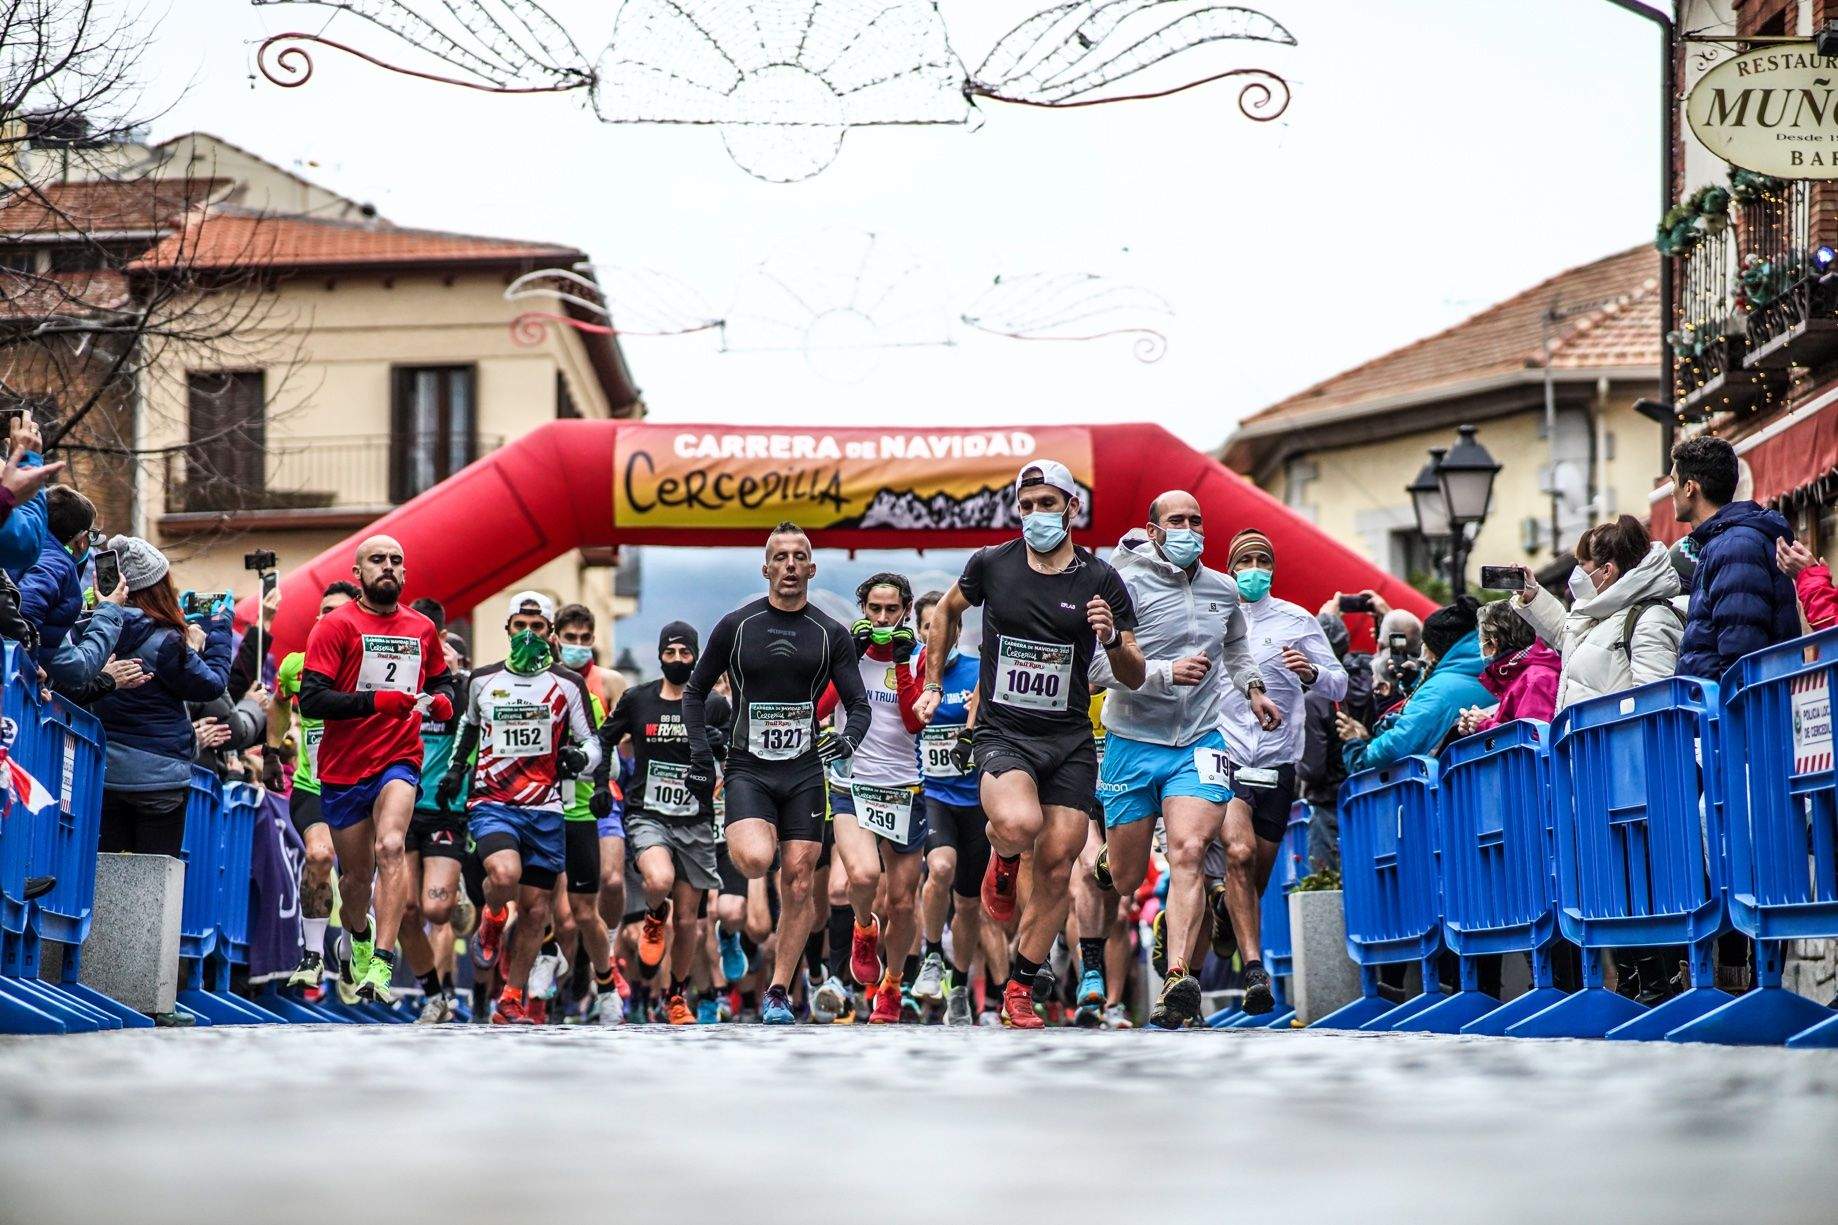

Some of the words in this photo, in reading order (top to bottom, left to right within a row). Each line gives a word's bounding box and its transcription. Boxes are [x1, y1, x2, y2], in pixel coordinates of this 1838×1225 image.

[1702, 78, 1838, 127] MUÑ
[1776, 133, 1823, 142] Desde
[673, 434, 841, 459] CARRERA
[846, 441, 877, 459] DE
[880, 432, 1036, 458] NAVIDAD
[385, 662, 397, 682] 2
[1007, 669, 1060, 697] 1040
[503, 728, 541, 746] 1152
[761, 728, 802, 749] 1327
[654, 785, 692, 805] 1092
[866, 807, 896, 830] 259
